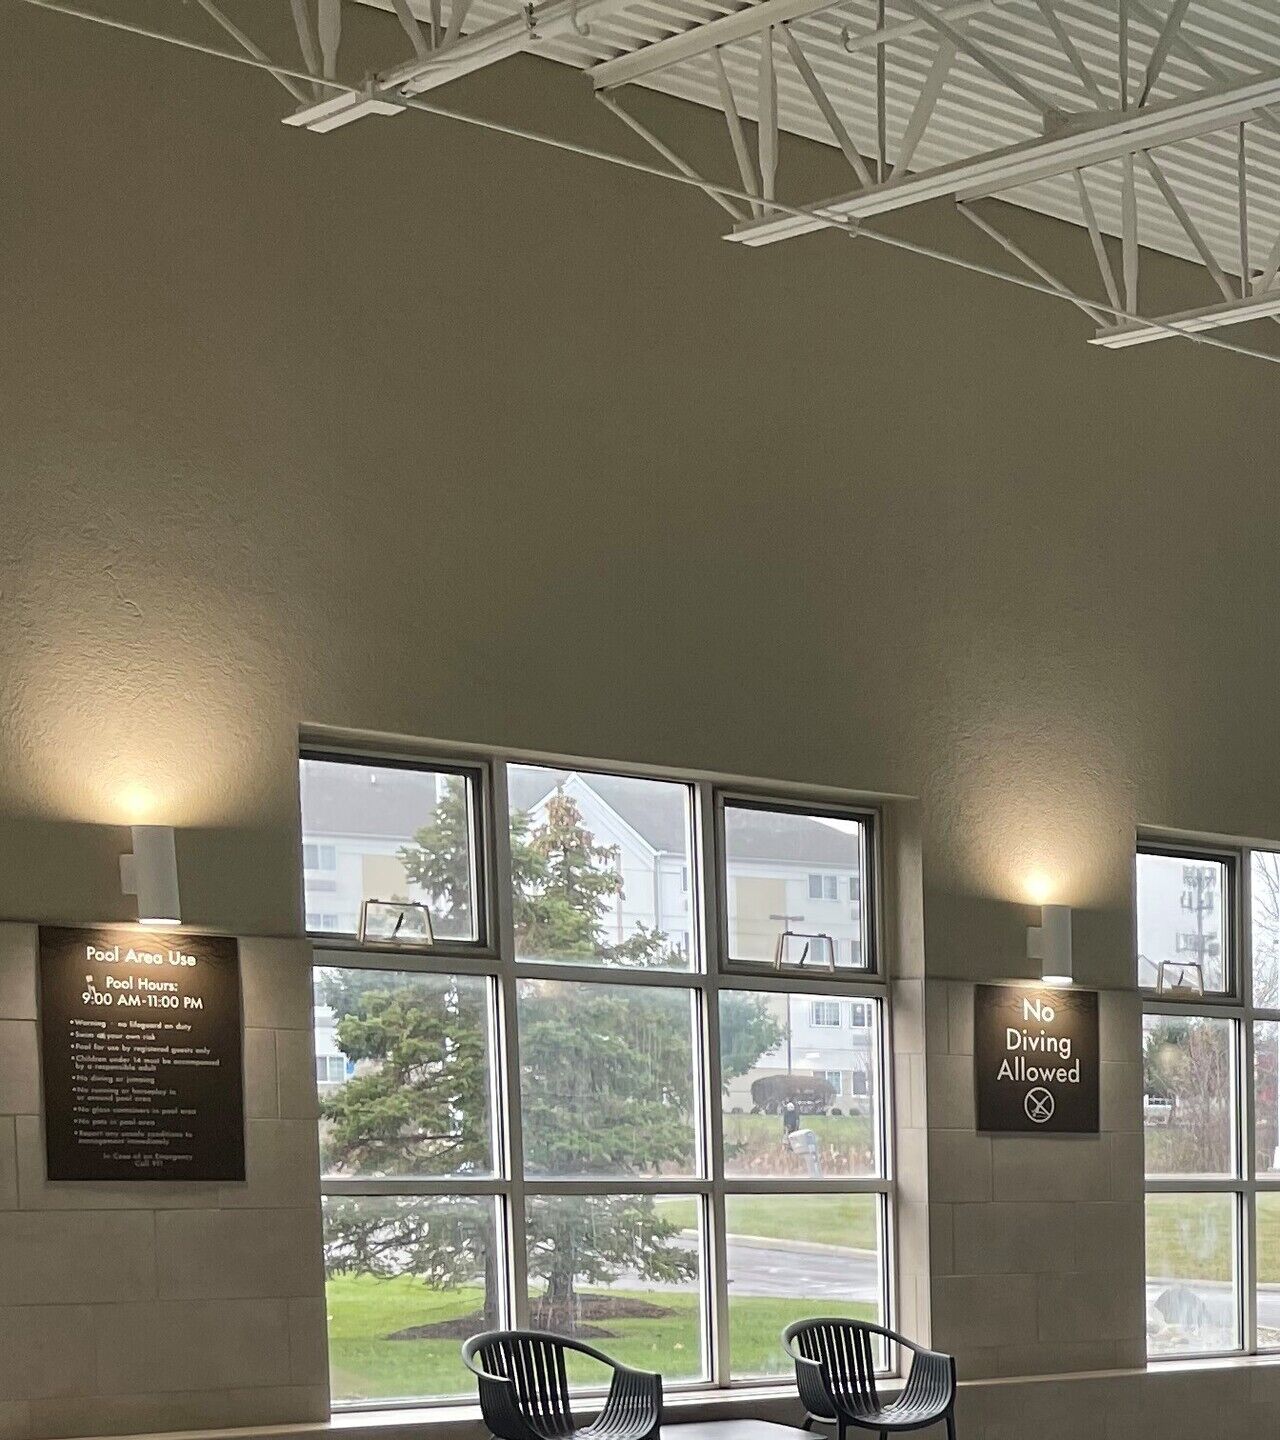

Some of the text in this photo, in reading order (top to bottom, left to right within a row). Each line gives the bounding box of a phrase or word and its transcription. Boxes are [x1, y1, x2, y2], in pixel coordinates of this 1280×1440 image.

[86, 945, 197, 967] Pool Area Use
[106, 975, 178, 992] Pool Hours:
[81, 991, 113, 1006] 9:00
[183, 996, 204, 1010] PM
[1023, 997, 1055, 1022] No
[1006, 1027, 1072, 1060] Diving
[996, 1055, 1081, 1084] Allowed
